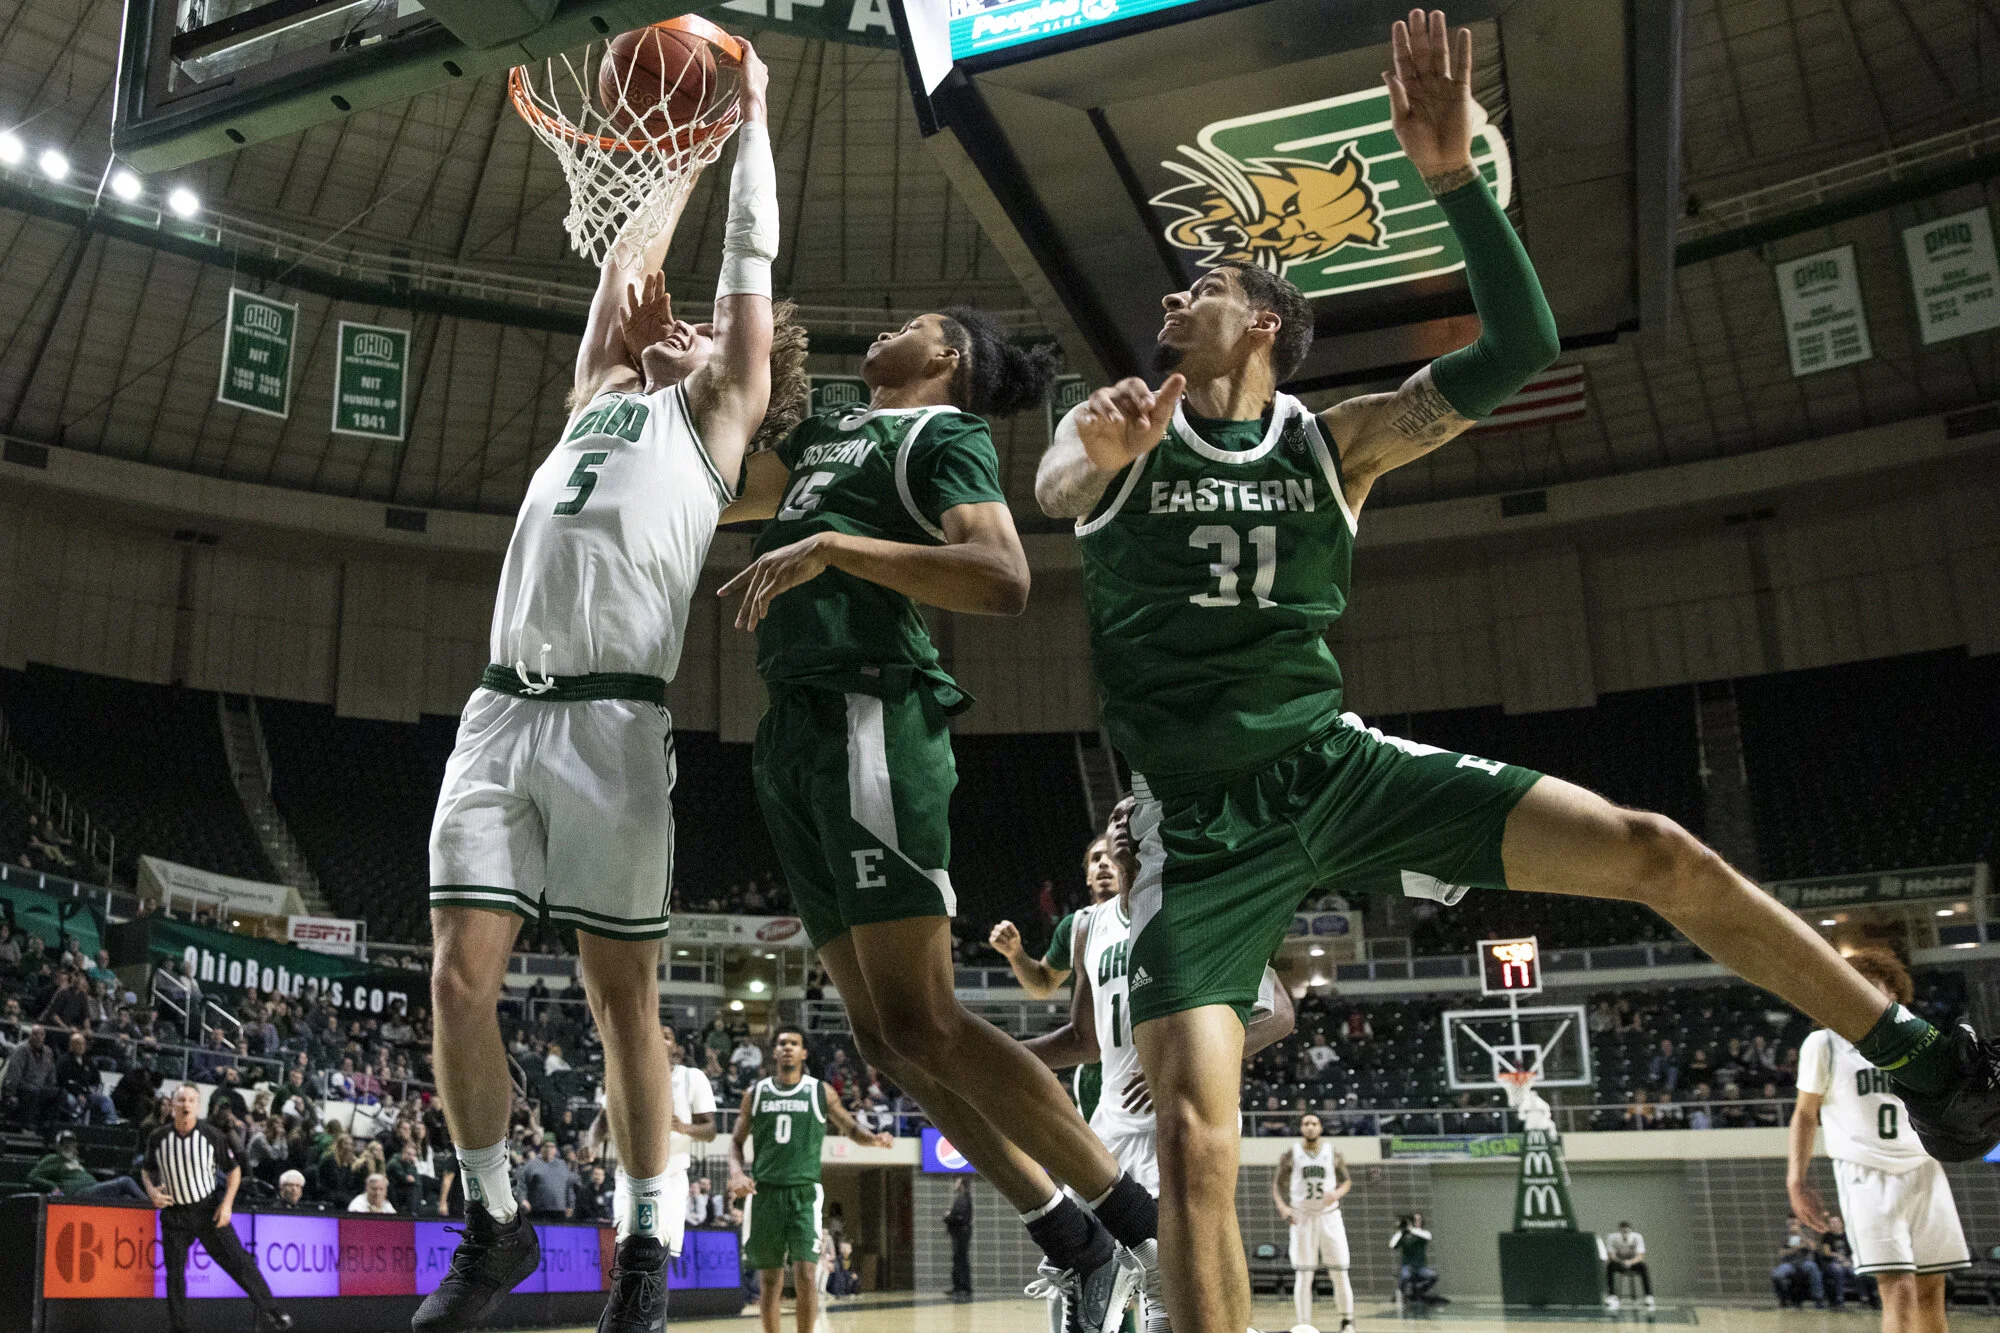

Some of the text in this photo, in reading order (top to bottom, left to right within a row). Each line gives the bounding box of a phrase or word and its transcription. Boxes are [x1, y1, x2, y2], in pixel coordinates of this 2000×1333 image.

[1042, 16, 1083, 34] BANK
[1924, 222, 1972, 254] OHIO
[244, 304, 282, 336] OHIO
[353, 333, 393, 361] OHIO
[360, 375, 382, 391] NIT
[353, 412, 386, 430] 1941
[551, 452, 610, 516] 5
[1149, 477, 1316, 514] EASTERN
[1188, 524, 1278, 609] 31
[850, 848, 887, 889] E
[294, 923, 351, 943] ESPN
[761, 1099, 809, 1113] EASTERN
[775, 1114, 792, 1144] 0
[1878, 1103, 1898, 1140] 0
[1302, 1165, 1326, 1180] OHIO
[1306, 1182, 1323, 1200] 35
[267, 1243, 387, 1274] COLUMBUS
